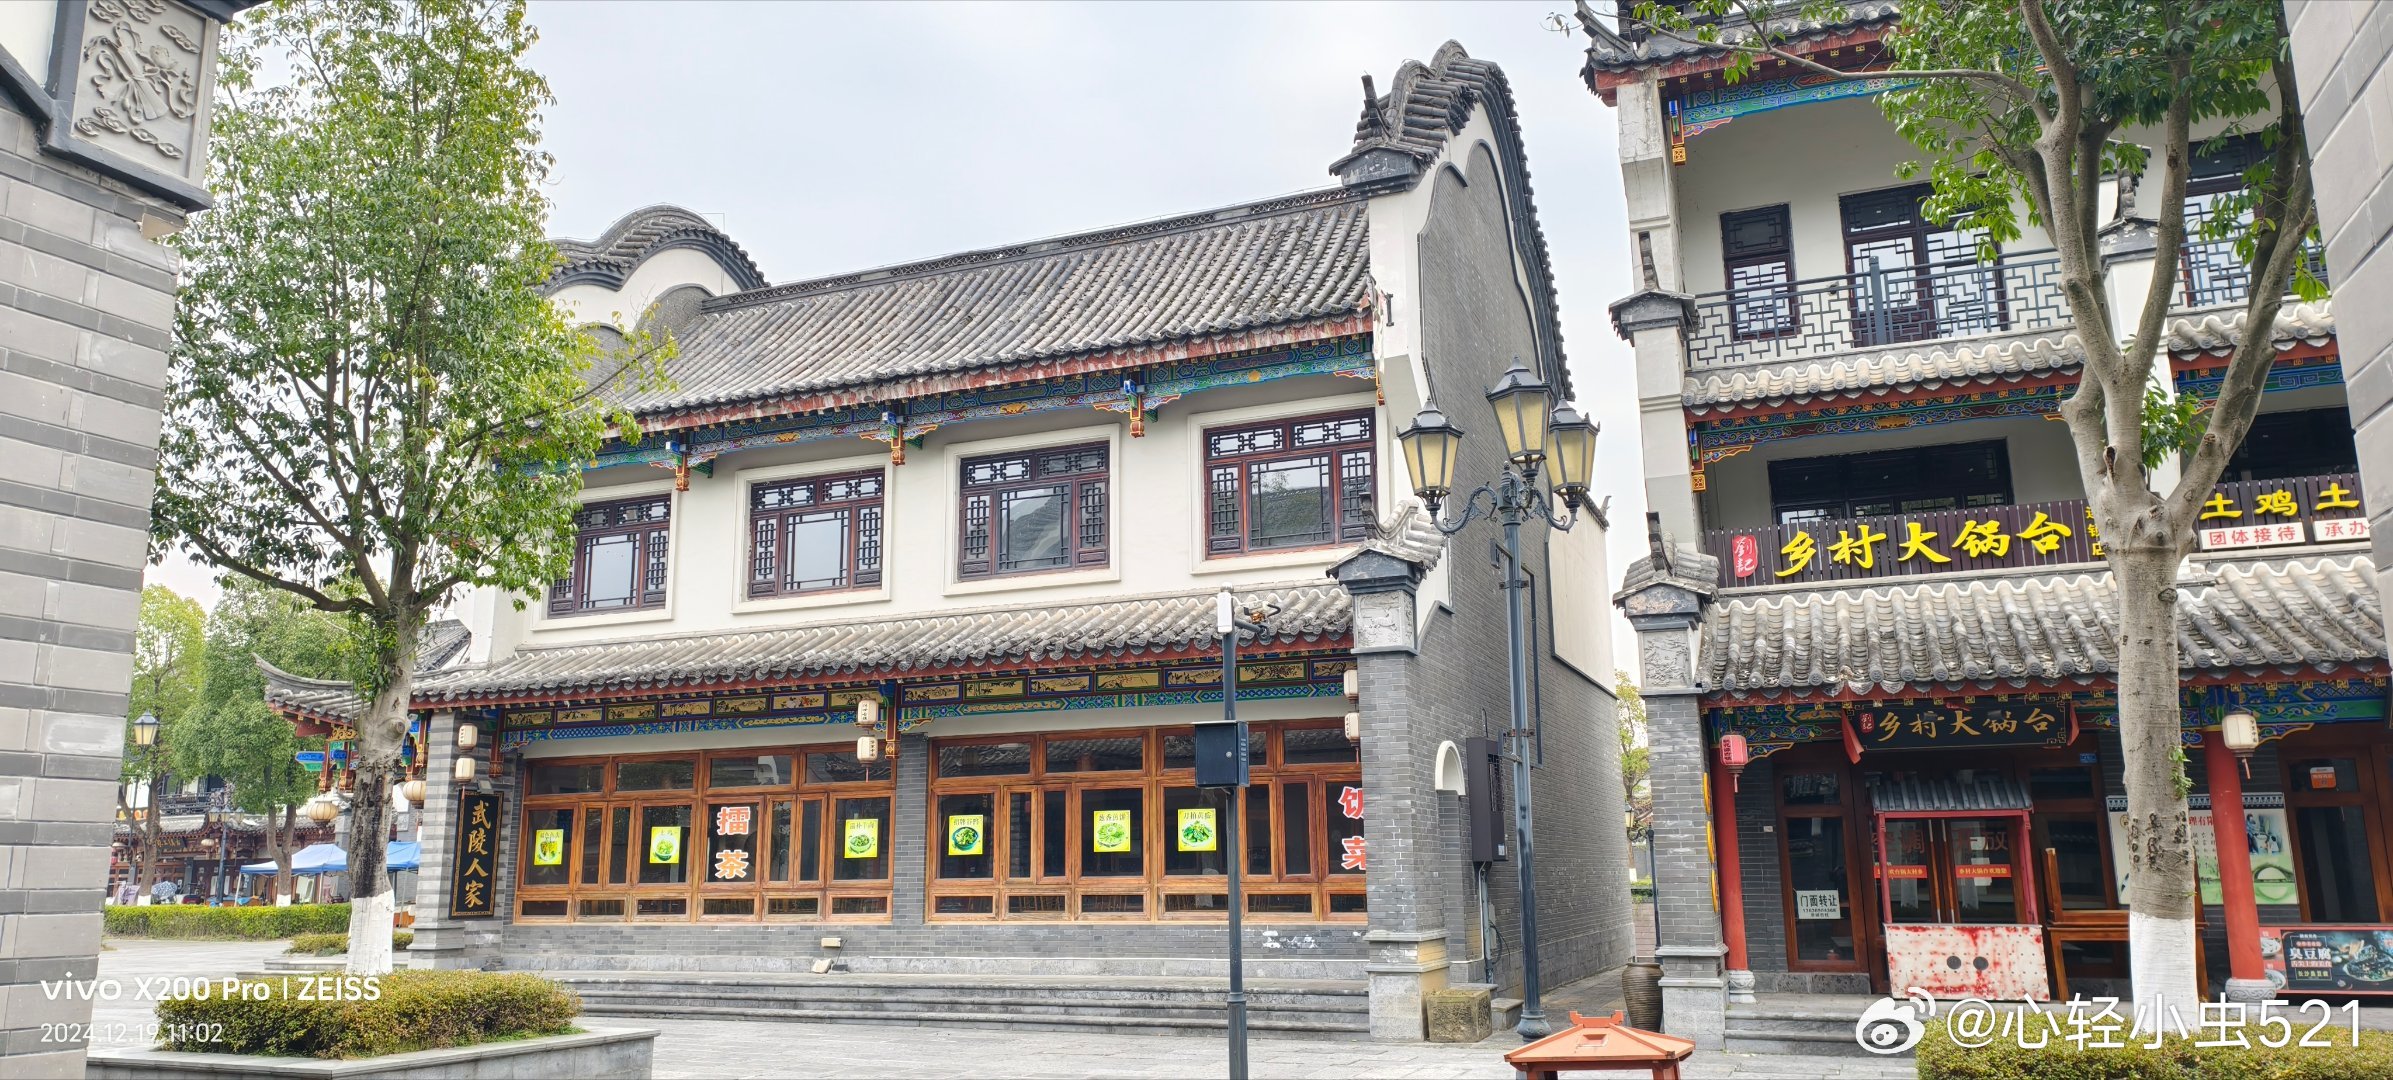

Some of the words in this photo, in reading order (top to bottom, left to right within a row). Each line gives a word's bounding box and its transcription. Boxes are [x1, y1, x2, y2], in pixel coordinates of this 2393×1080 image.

[1775, 511, 2072, 577] 乡村大锅台
[2209, 526, 2296, 546] 团体接待
[1878, 708, 2055, 741] 乡村大锅台
[464, 800, 492, 907] 武陵人家
[715, 806, 751, 879] 擂茶
[1800, 894, 1838, 907] 门面转让
[2289, 947, 2332, 960] 臭豆腐
